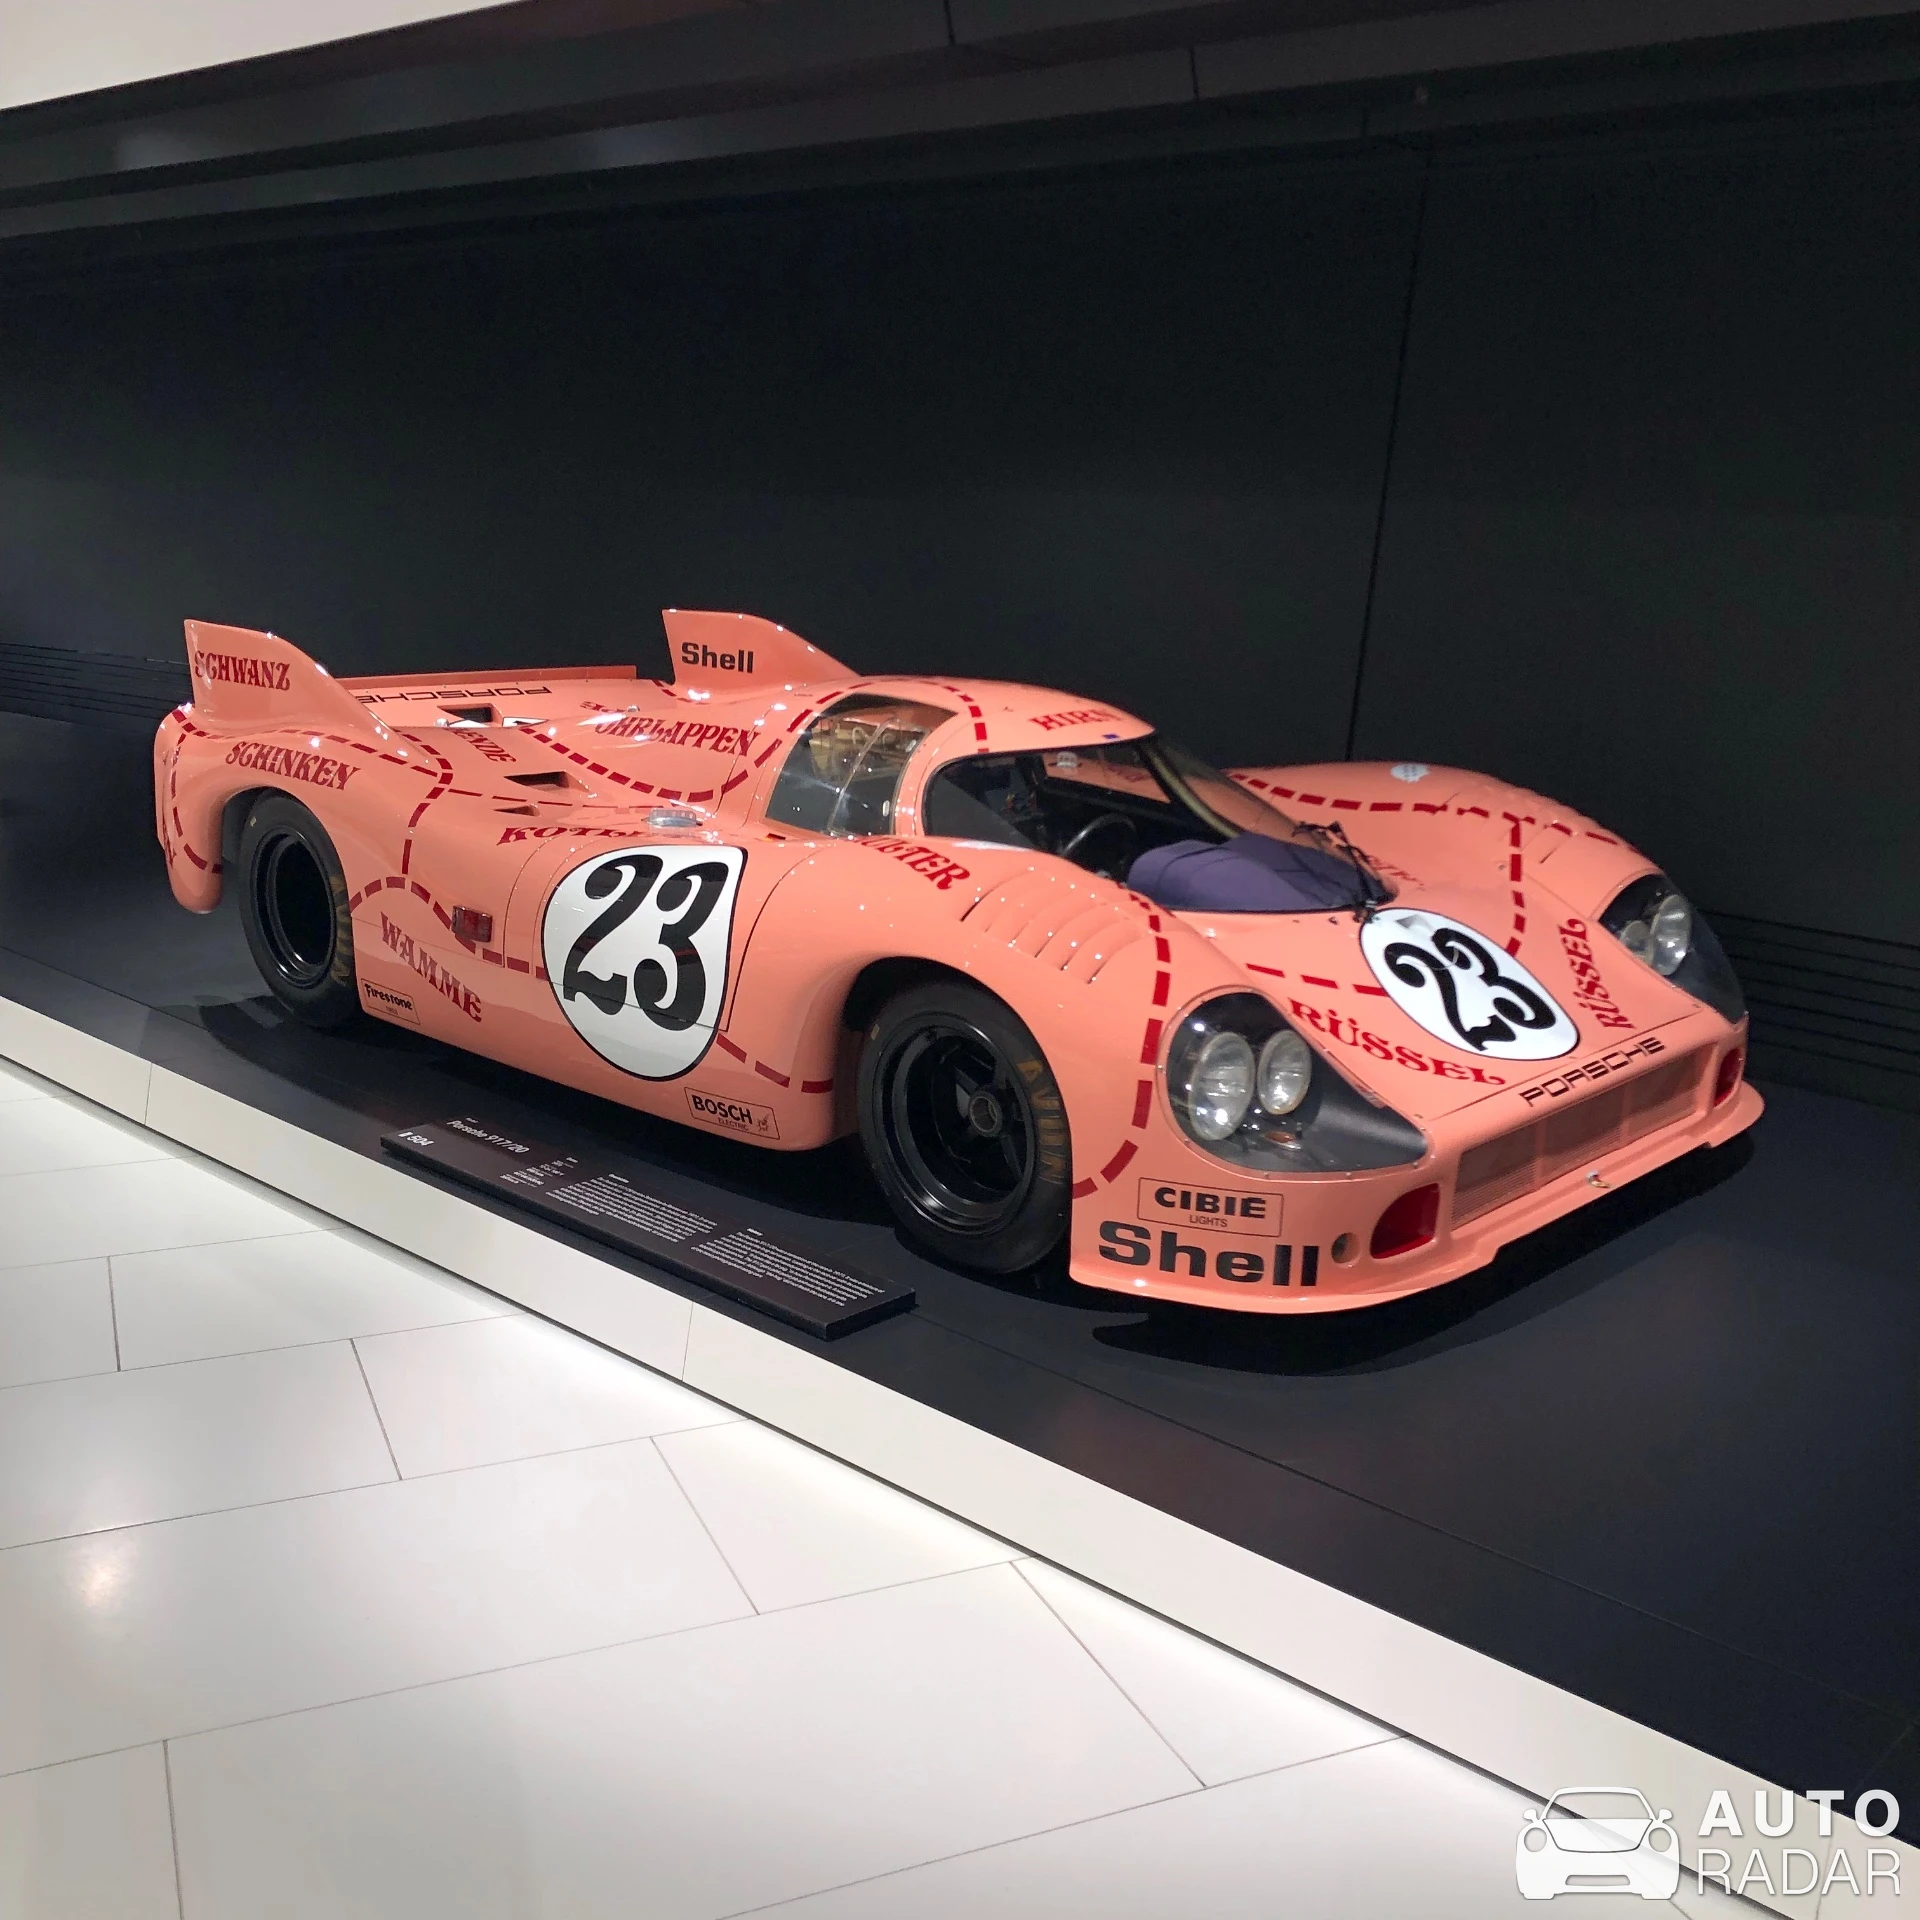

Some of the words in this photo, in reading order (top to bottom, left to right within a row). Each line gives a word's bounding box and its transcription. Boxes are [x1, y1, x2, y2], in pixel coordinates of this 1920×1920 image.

[194, 652, 290, 691] SCHWANZ
[681, 642, 754, 674] Shell
[225, 741, 361, 791] SCHINKEN
[380, 911, 482, 1023] WAMME
[563, 854, 729, 1031] 23
[1557, 918, 1636, 1029] RÜSSEL
[1384, 928, 1557, 1052] 23
[1288, 998, 1506, 1085] RÜSSEL
[1518, 1037, 1666, 1107] PORSCHE
[691, 1095, 752, 1124] BOSCH
[1099, 1220, 1320, 1287] Shell
[1189, 1213, 1228, 1228] LIGHTS
